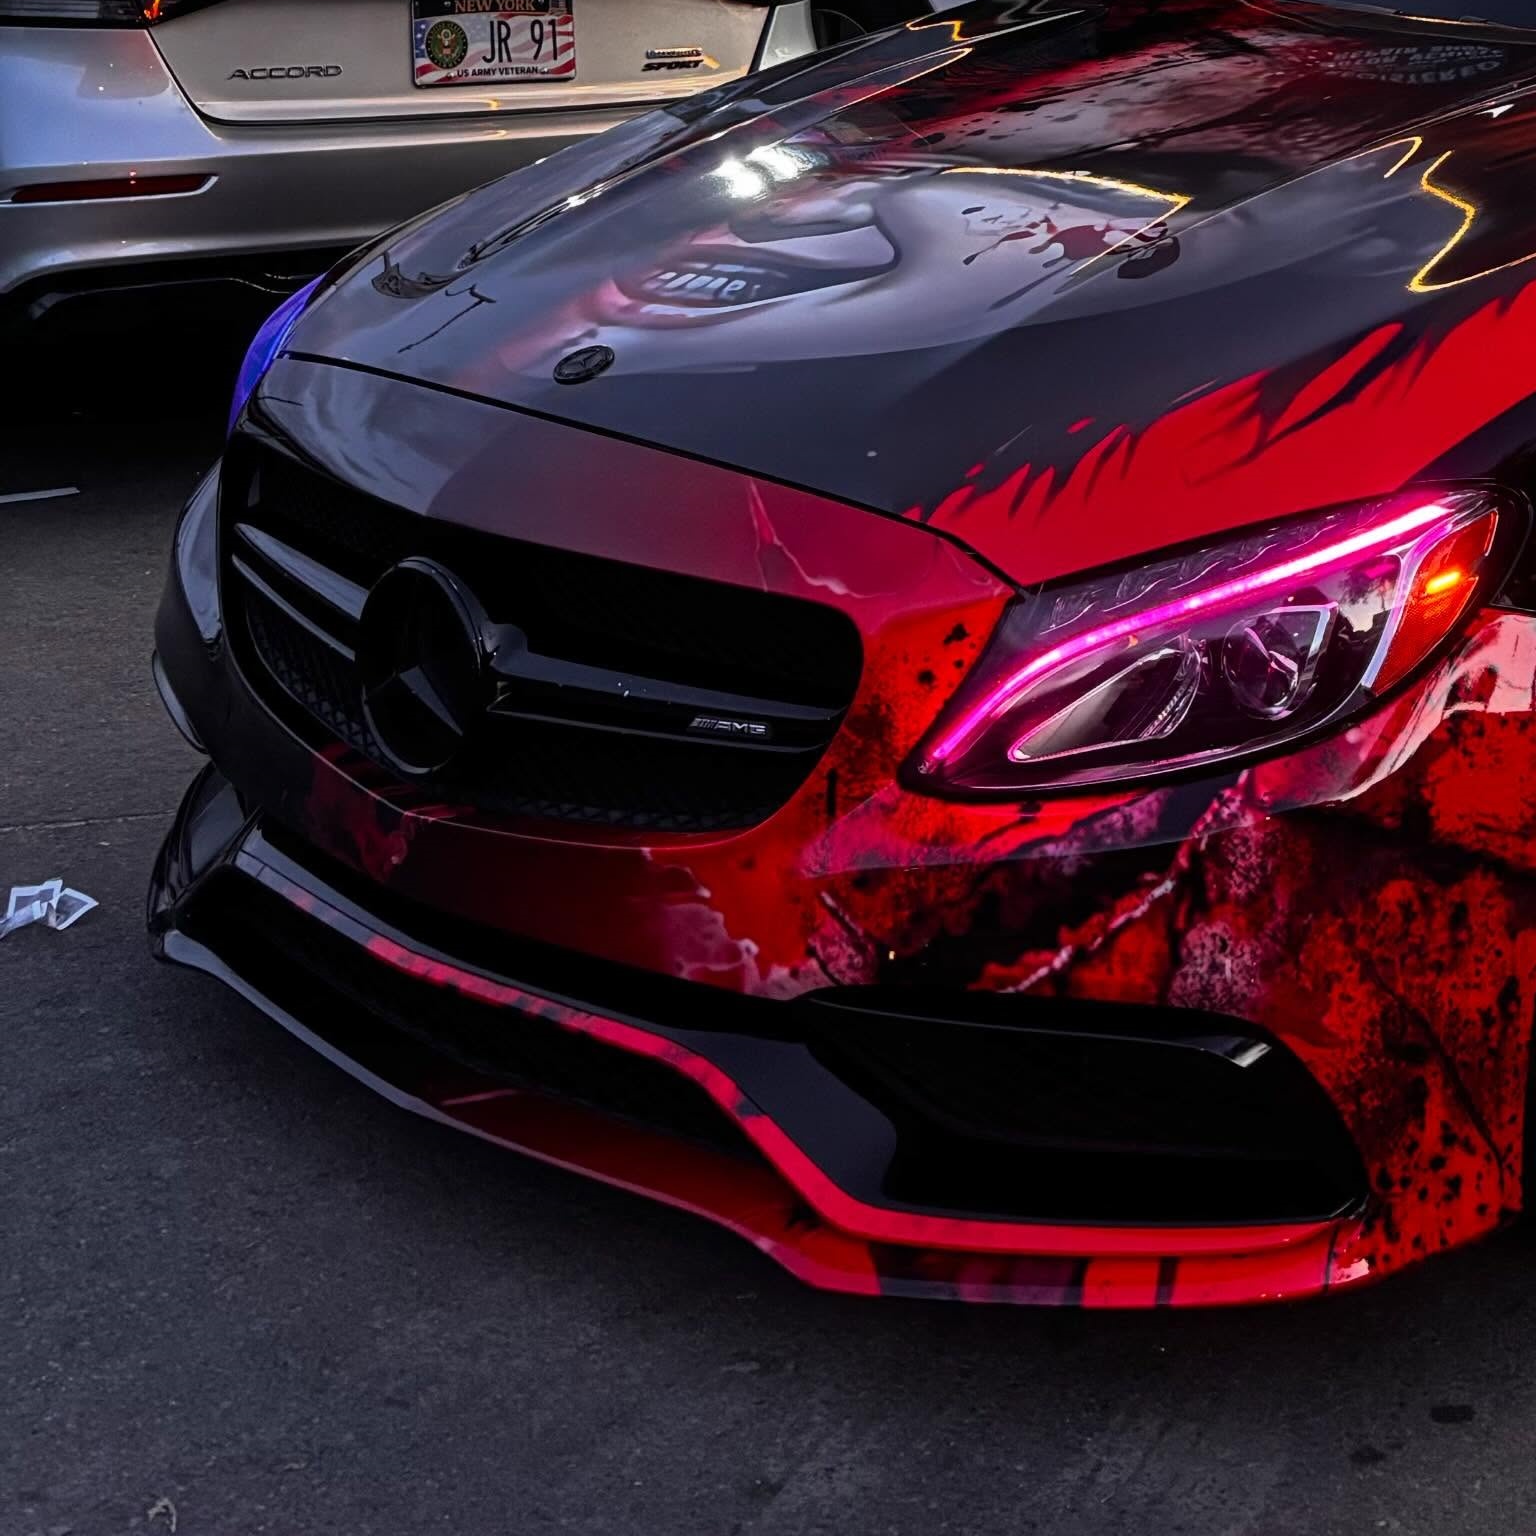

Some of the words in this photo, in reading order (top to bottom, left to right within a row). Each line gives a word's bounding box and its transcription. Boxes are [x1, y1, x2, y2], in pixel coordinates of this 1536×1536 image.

[454, 0, 492, 13] NEW
[482, 20, 513, 64] JR
[530, 19, 558, 61] 91
[227, 64, 344, 80] ACCORD
[456, 69, 469, 78] US
[471, 67, 498, 77] ARMY
[499, 66, 539, 76] VETERAN
[711, 719, 767, 735] AMG
